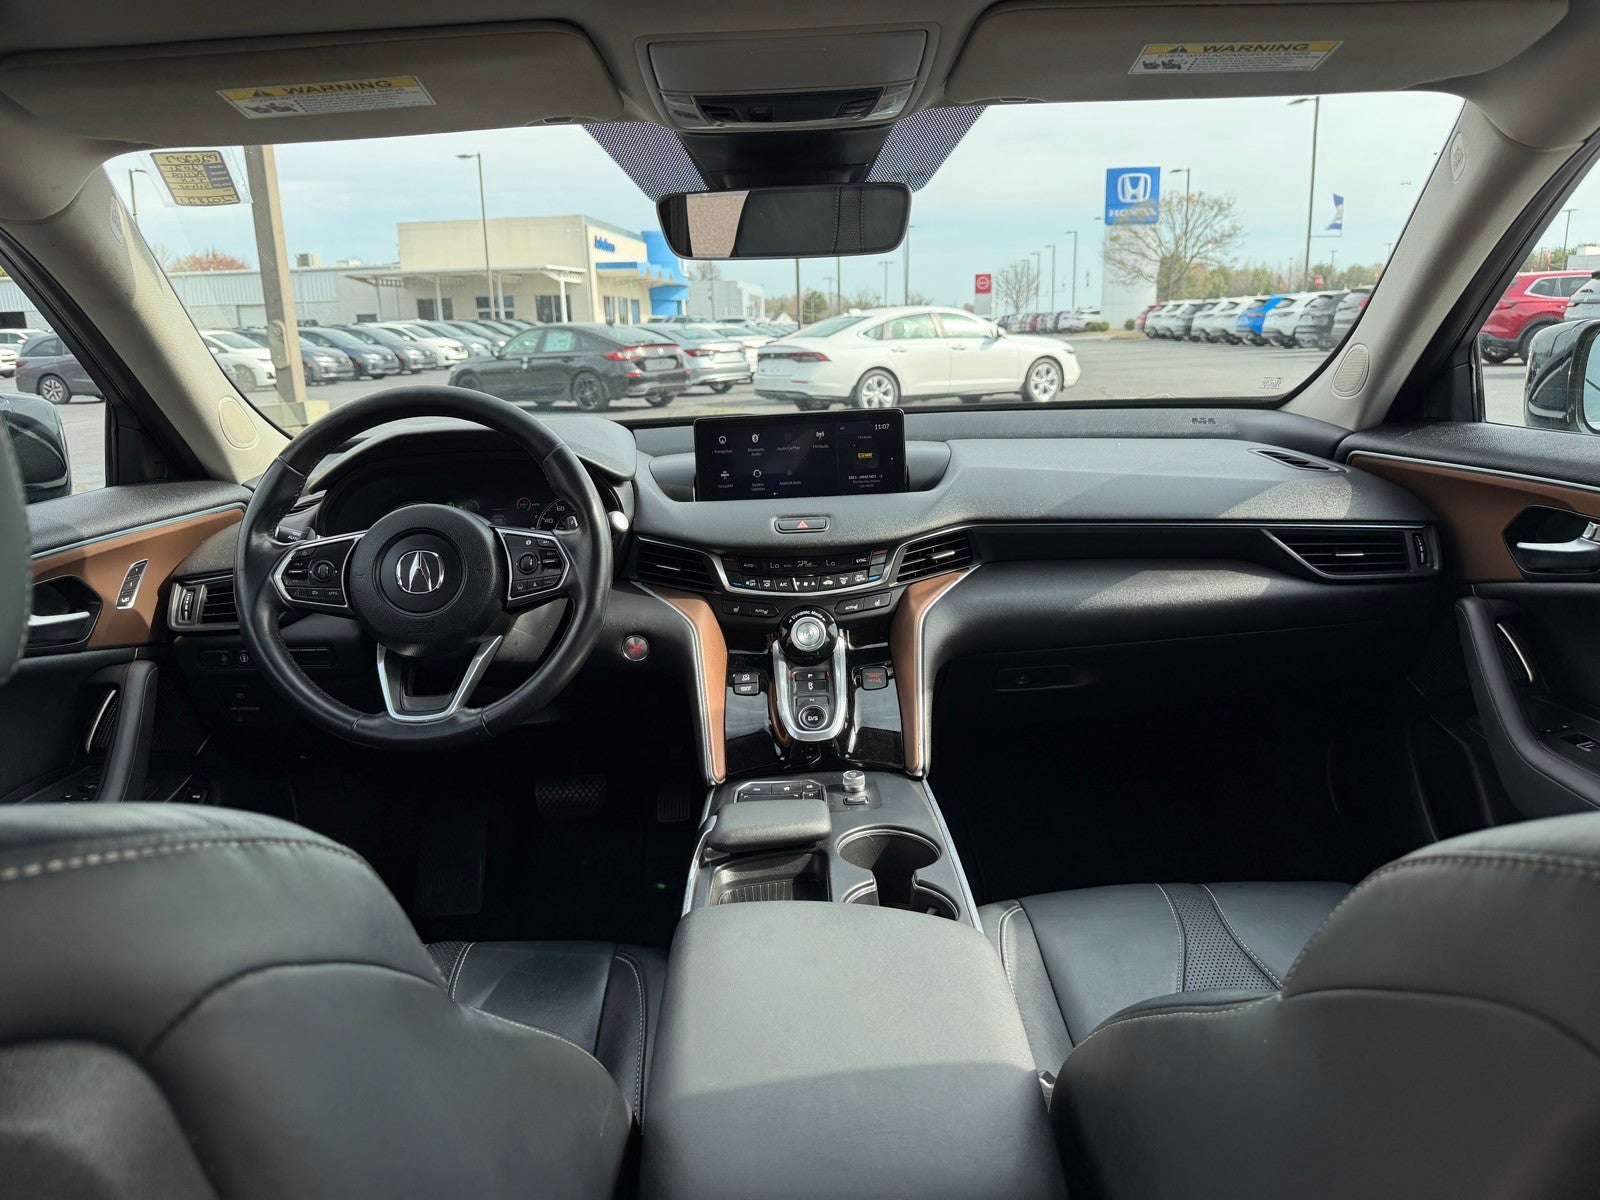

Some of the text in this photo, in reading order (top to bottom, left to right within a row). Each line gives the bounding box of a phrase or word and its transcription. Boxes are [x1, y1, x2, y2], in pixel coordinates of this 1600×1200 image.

[1201, 43, 1310, 53] WARNING
[281, 80, 393, 95] WARNING
[769, 561, 780, 569] Lo
[791, 610, 824, 620] Dynamic Mode
